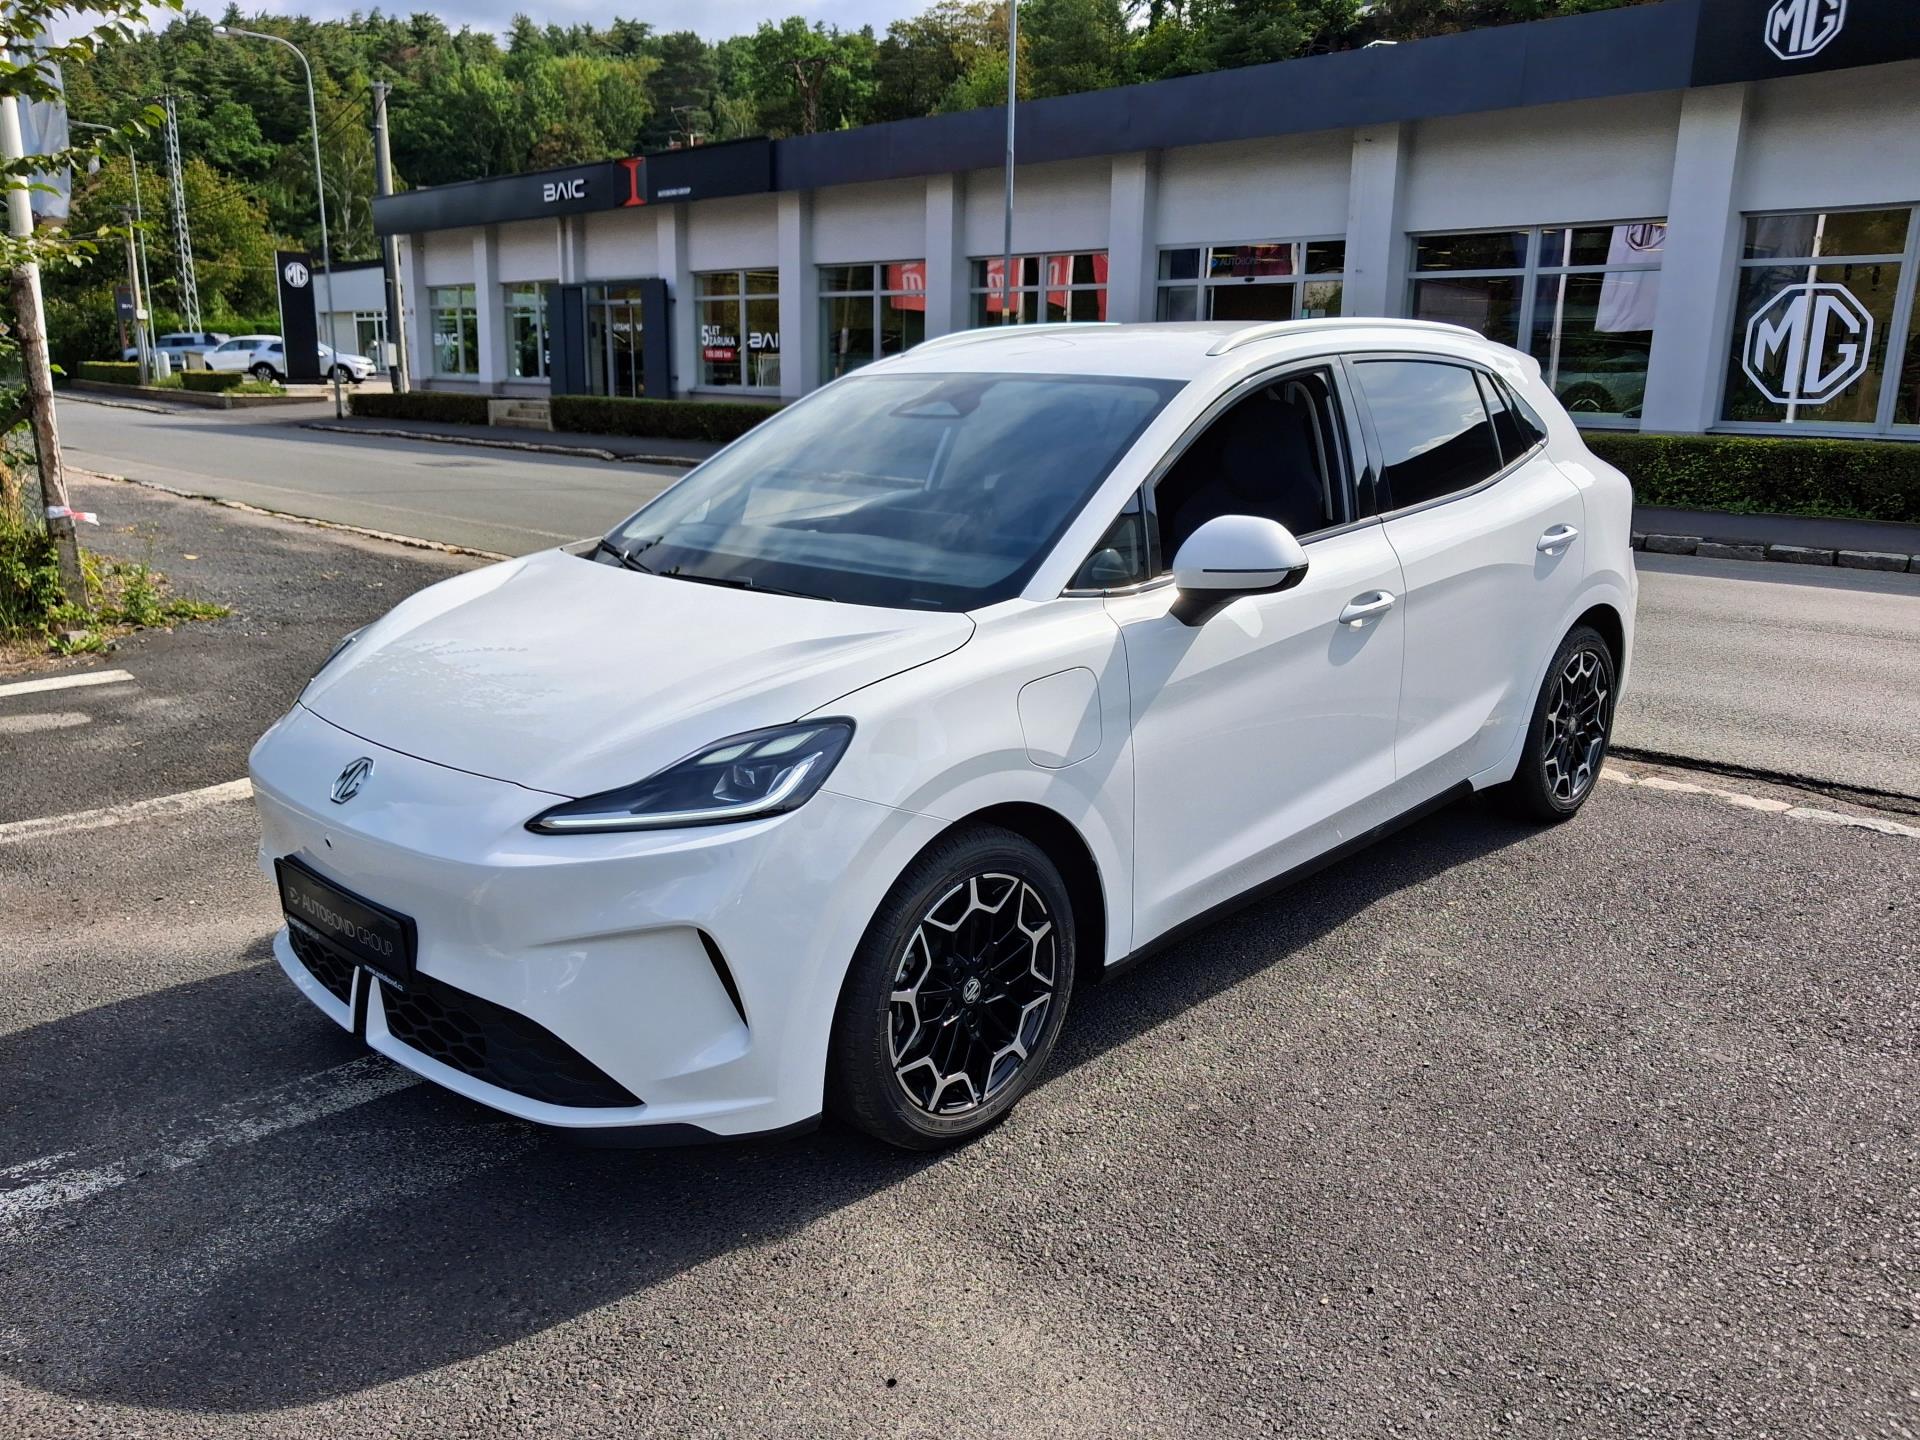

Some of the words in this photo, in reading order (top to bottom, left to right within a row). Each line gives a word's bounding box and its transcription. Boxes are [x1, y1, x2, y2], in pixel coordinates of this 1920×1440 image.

[1772, 0, 1838, 53] MG
[543, 178, 585, 203] BAIC
[287, 264, 306, 286] MG
[701, 325, 709, 346] 5
[749, 331, 779, 349] BAI
[1754, 295, 1861, 393] MG
[335, 760, 369, 800] MG
[302, 894, 356, 938] AUTOBOND
[356, 926, 393, 957] GROUP
